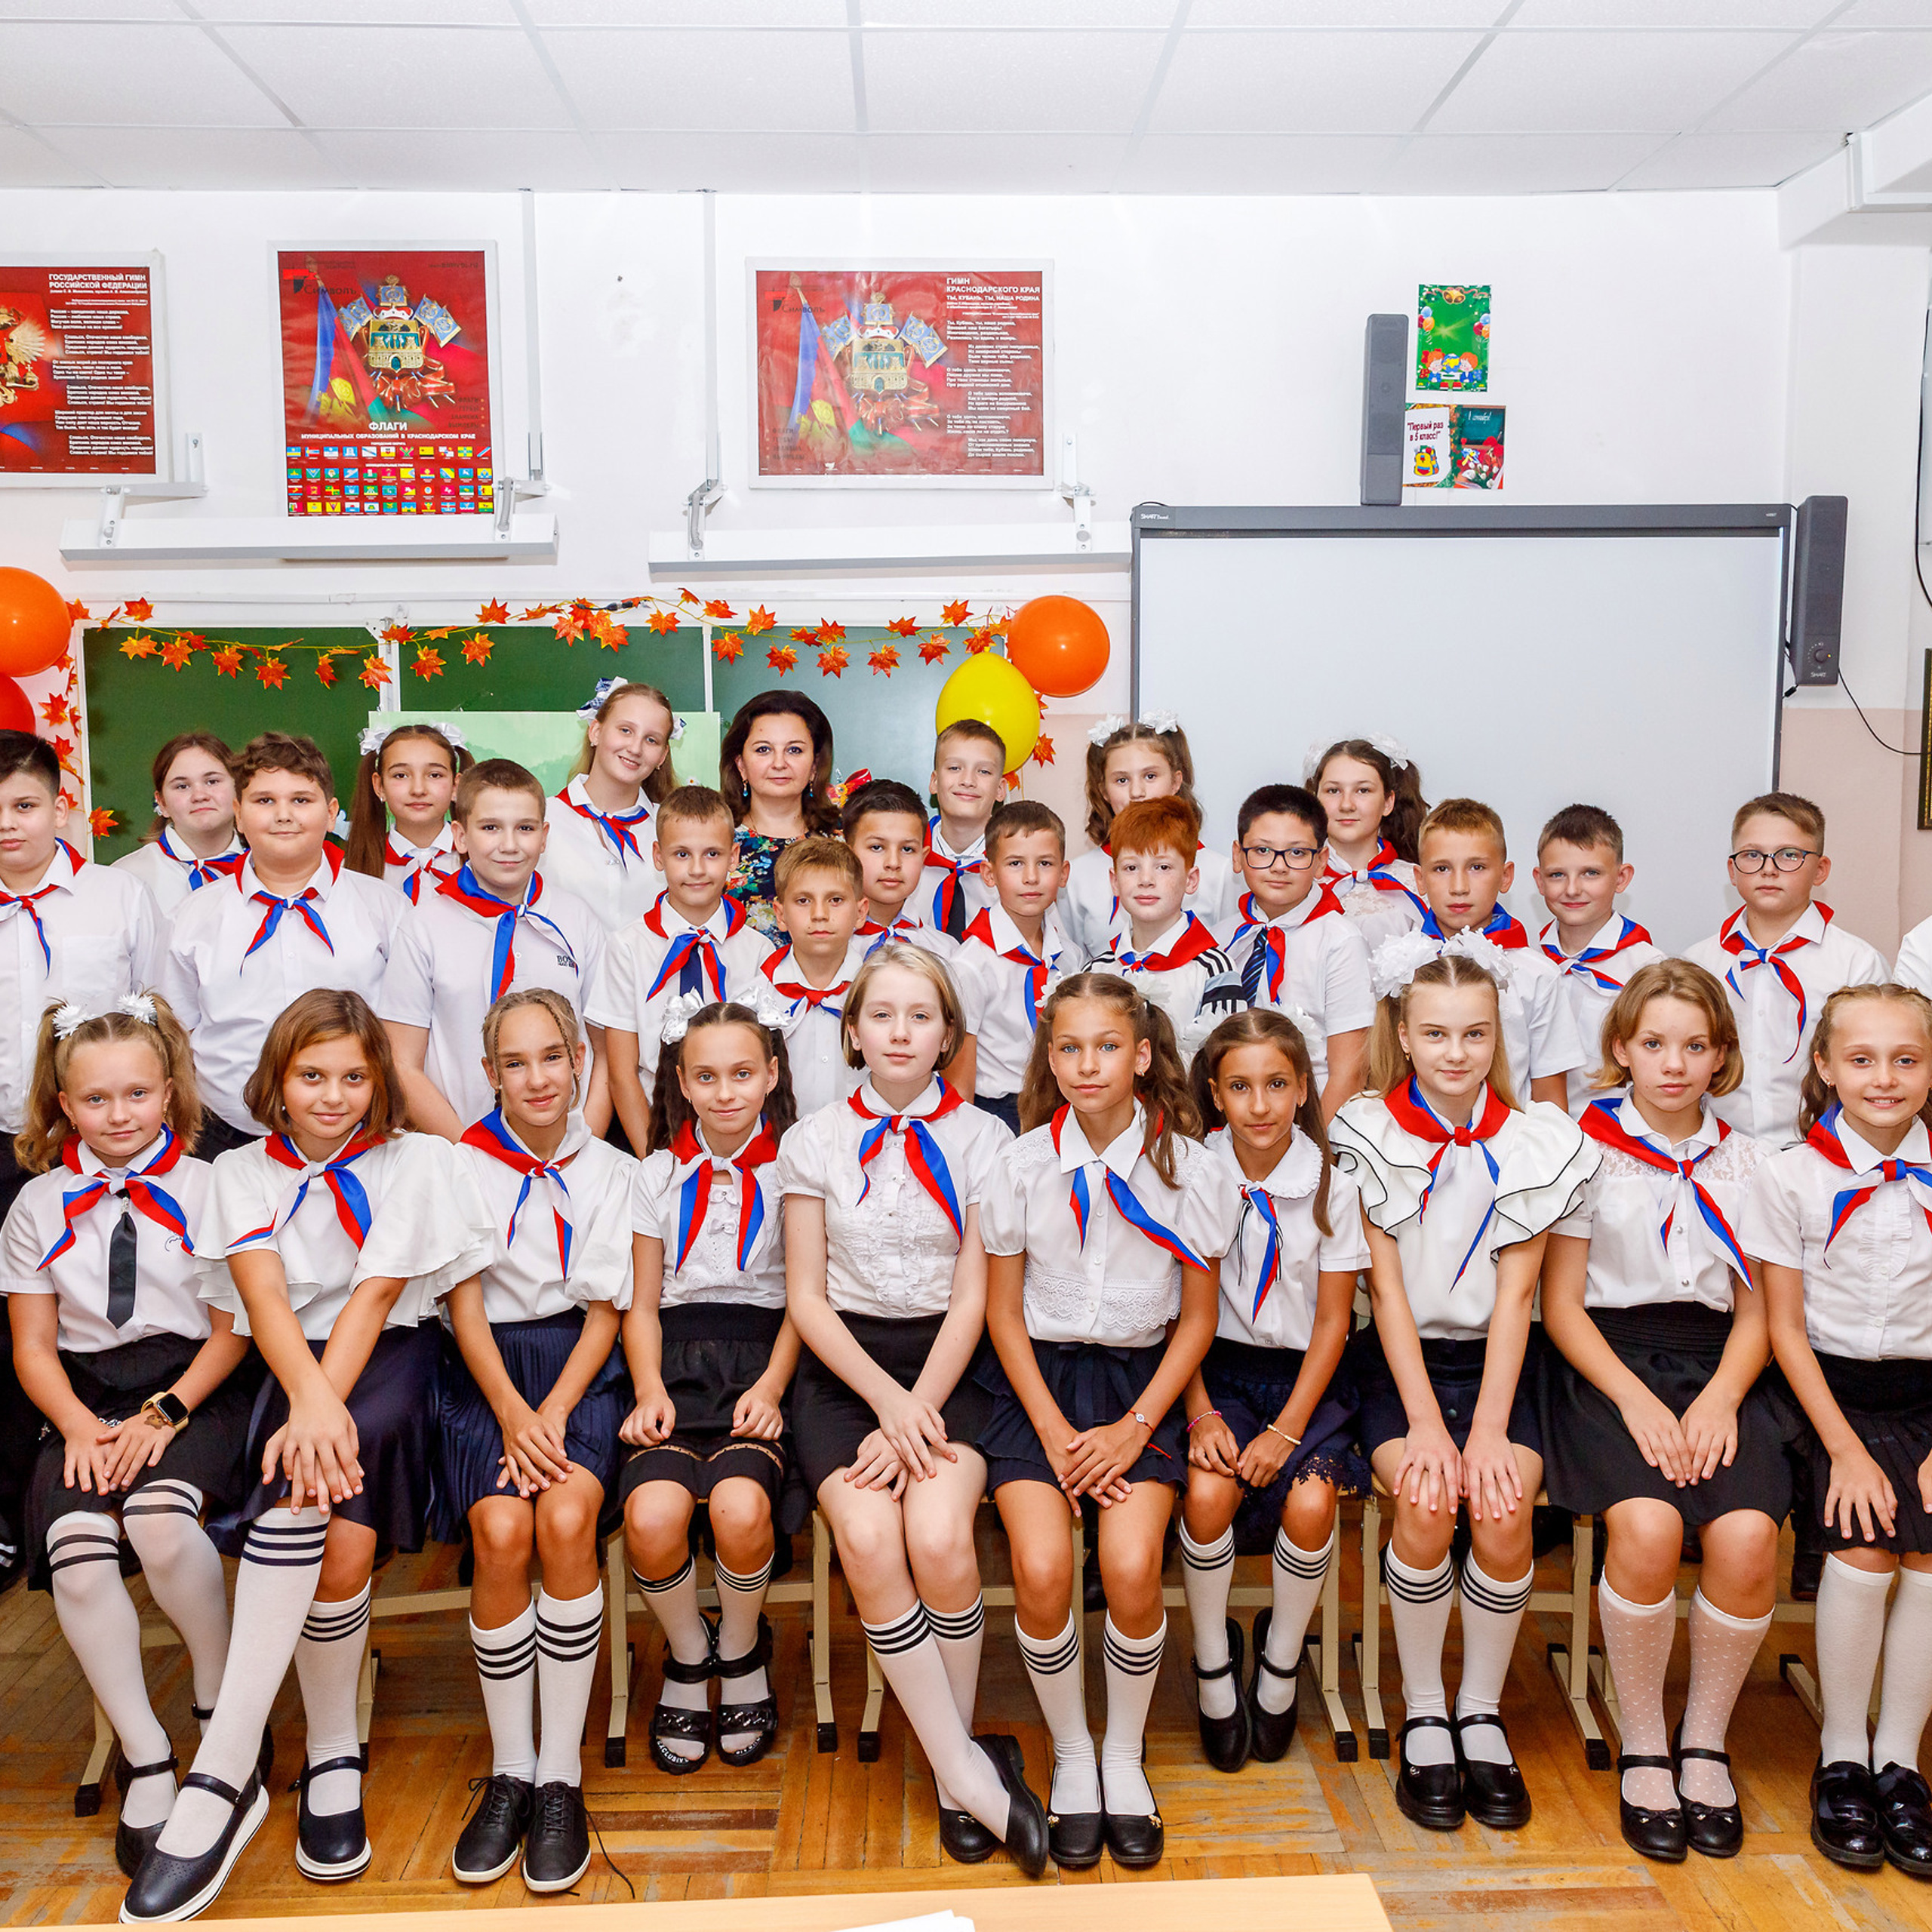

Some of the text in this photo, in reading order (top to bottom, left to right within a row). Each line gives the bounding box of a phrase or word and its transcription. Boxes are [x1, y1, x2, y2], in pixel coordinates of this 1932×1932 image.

[368, 421, 408, 431] ФЛАГИ
[1433, 422, 1444, 431] раз
[1414, 432, 1418, 441] 5
